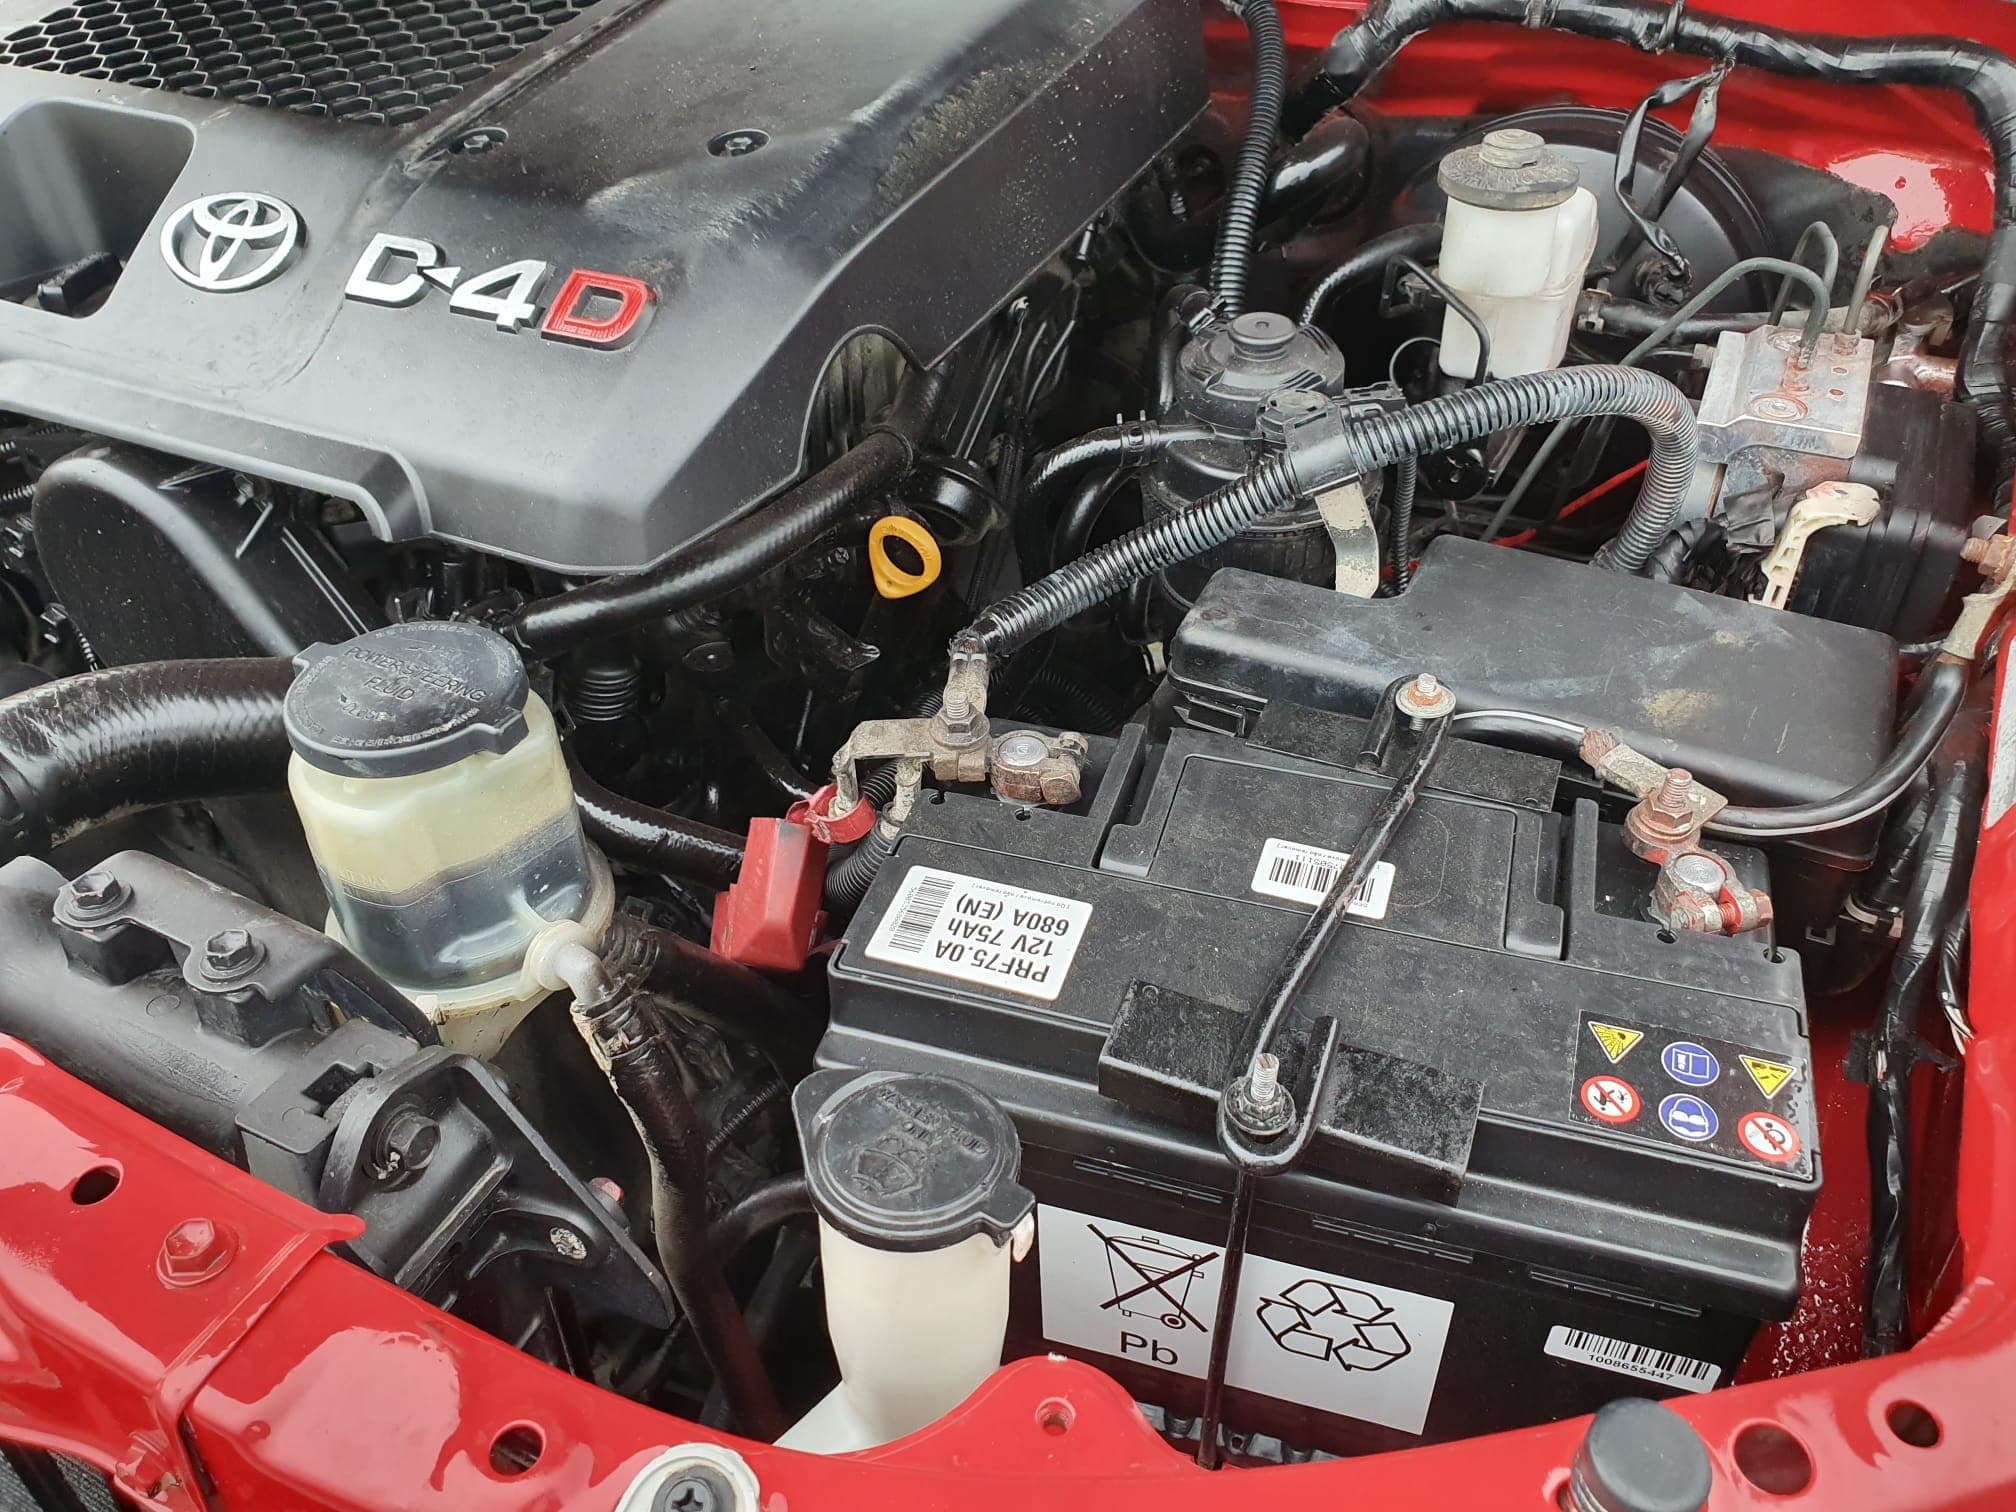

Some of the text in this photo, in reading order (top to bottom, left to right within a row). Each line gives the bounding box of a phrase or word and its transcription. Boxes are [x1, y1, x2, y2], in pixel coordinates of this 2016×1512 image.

[344, 646, 487, 703] POWER STEERING
[364, 676, 415, 701] FLUID
[956, 893, 1070, 936] 680A (EN)
[948, 917, 1054, 957] 12V 75Ah
[935, 939, 1050, 983] PRF75.0A
[1119, 1330, 1178, 1366] Pb
[1588, 1354, 1675, 1381] 1008655447
